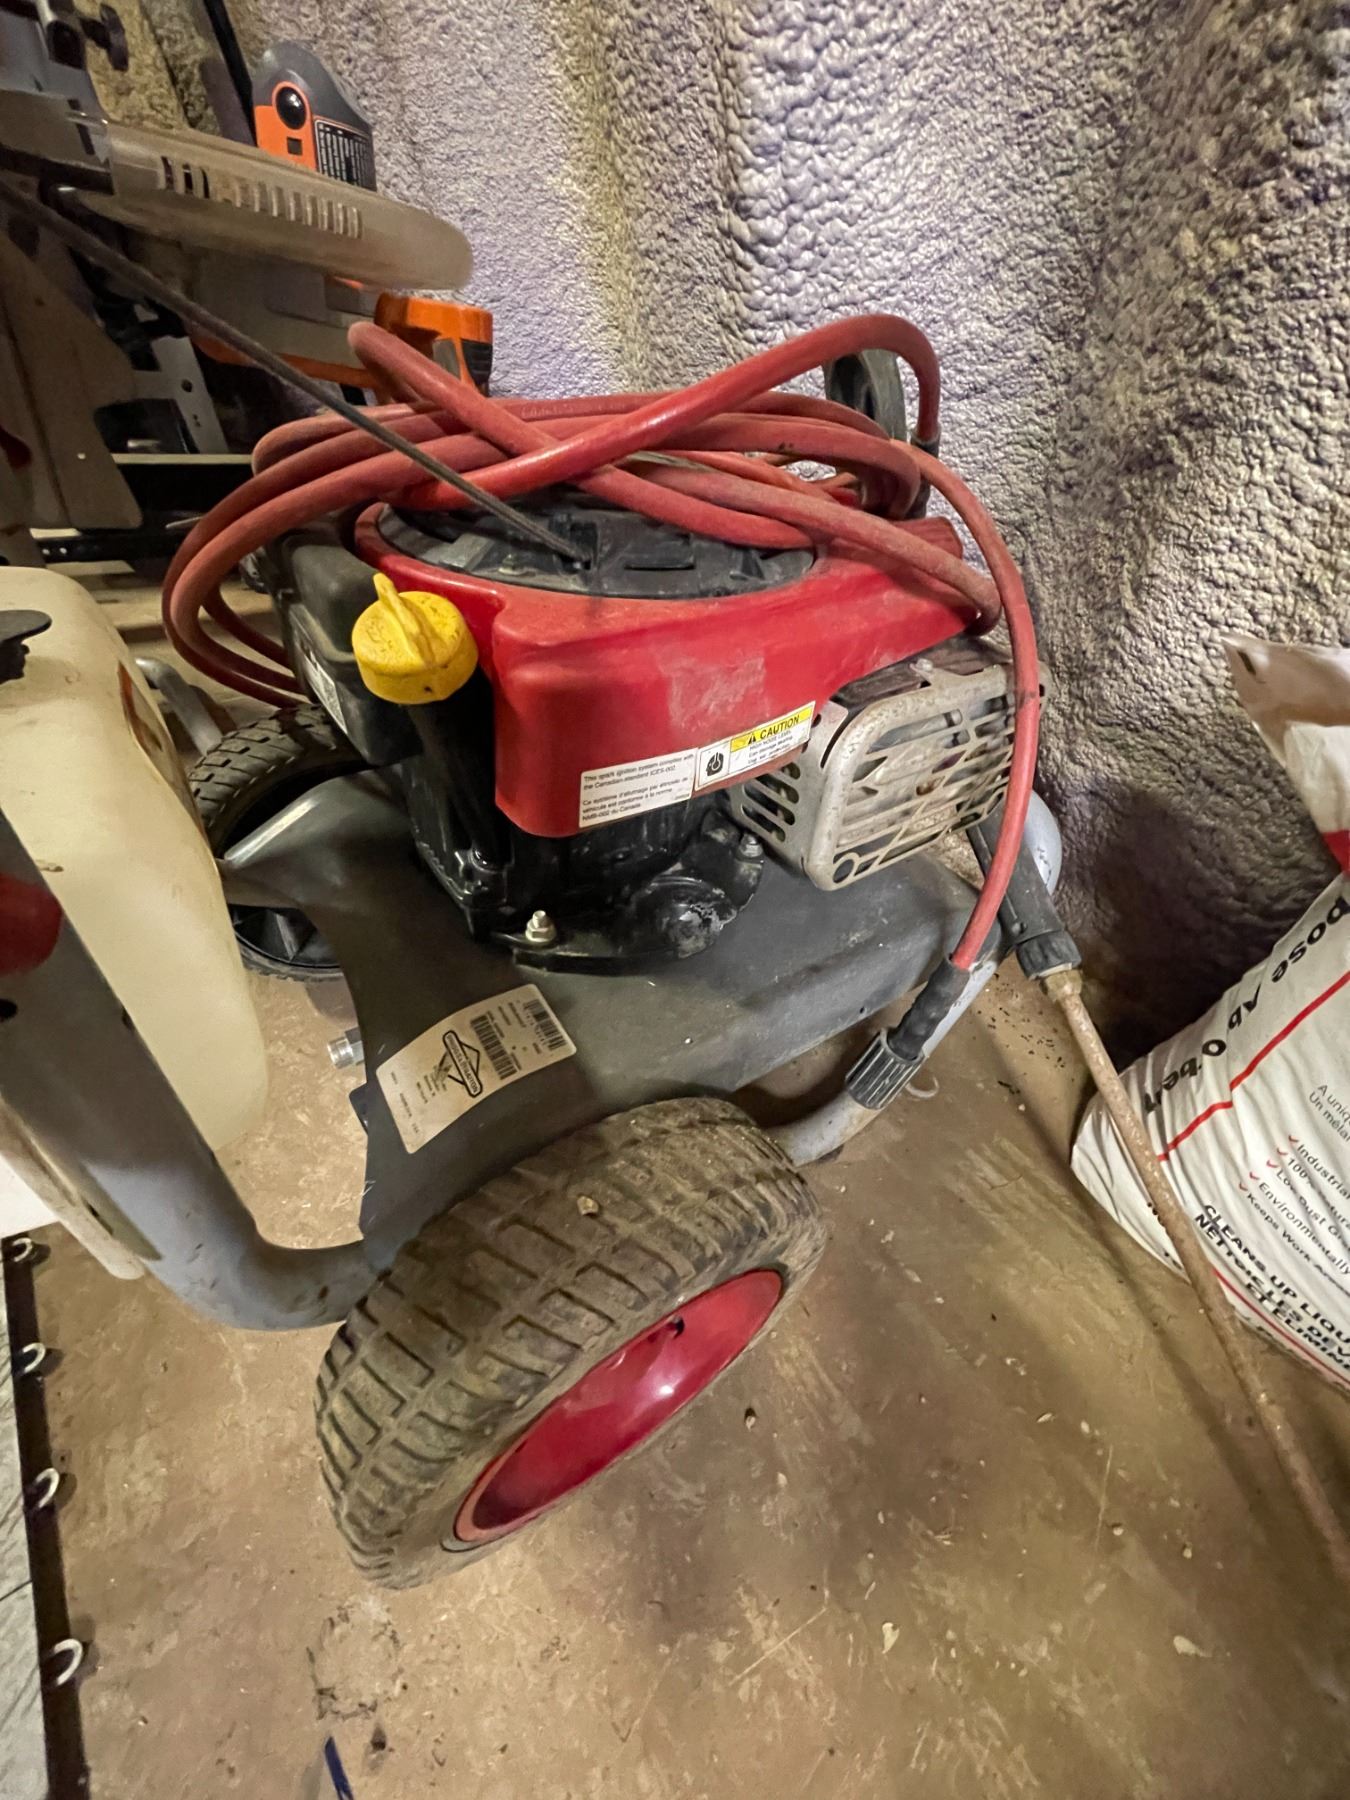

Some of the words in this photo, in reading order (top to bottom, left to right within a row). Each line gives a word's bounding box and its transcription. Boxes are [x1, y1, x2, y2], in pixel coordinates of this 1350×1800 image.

[760, 714, 800, 740] CAUTION
[595, 777, 623, 788] Canadian
[617, 766, 636, 776] ignition
[638, 762, 658, 772] system
[1309, 1091, 1324, 1111] Un
[1317, 1084, 1328, 1096] A
[1327, 1095, 1350, 1124] uniq
[1300, 1195, 1326, 1224] Dust
[1247, 1193, 1279, 1230] Keeps
[1283, 1230, 1311, 1262] Work
[1259, 1182, 1350, 1274] Environmentally
[1204, 1204, 1266, 1272] CLEANS
[1270, 1274, 1298, 1299] UP
[1266, 1290, 1303, 1322] LES
